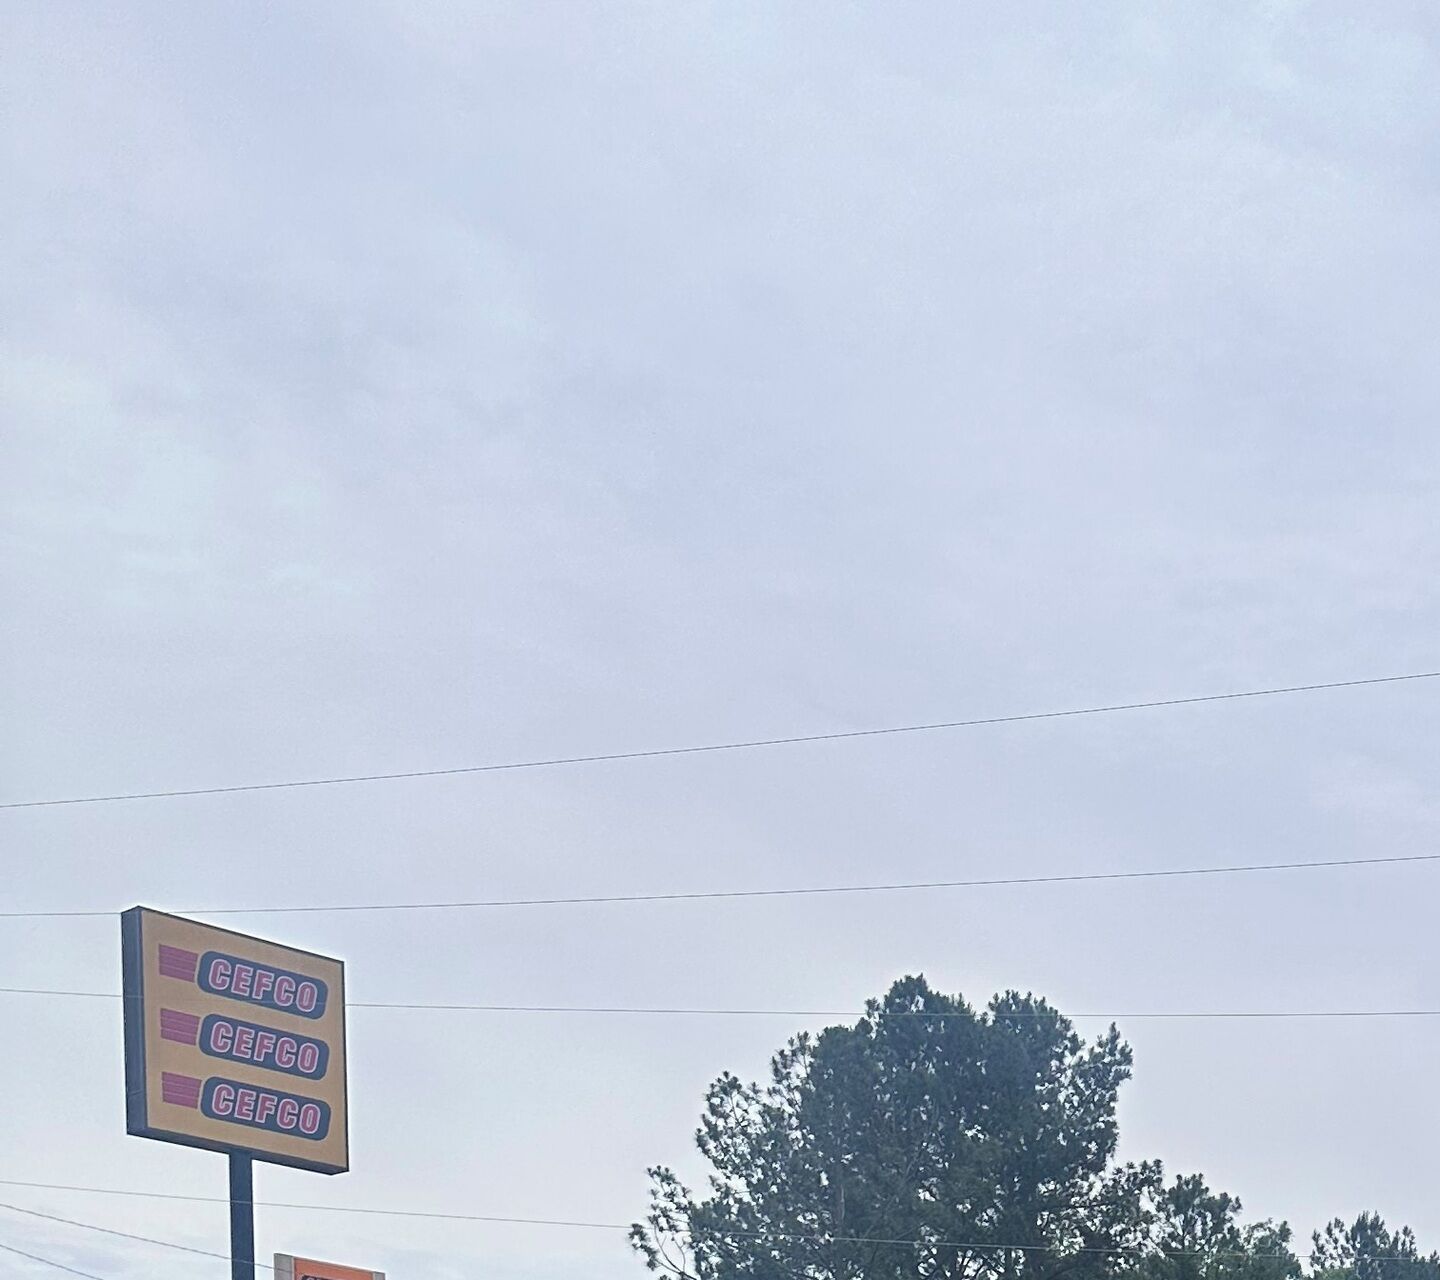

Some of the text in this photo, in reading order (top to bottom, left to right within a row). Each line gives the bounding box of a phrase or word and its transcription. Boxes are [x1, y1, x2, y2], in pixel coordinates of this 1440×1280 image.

[208, 958, 318, 1012] CEFCO
[210, 1021, 319, 1074] CEFCO
[211, 1084, 321, 1134] CEFCO
